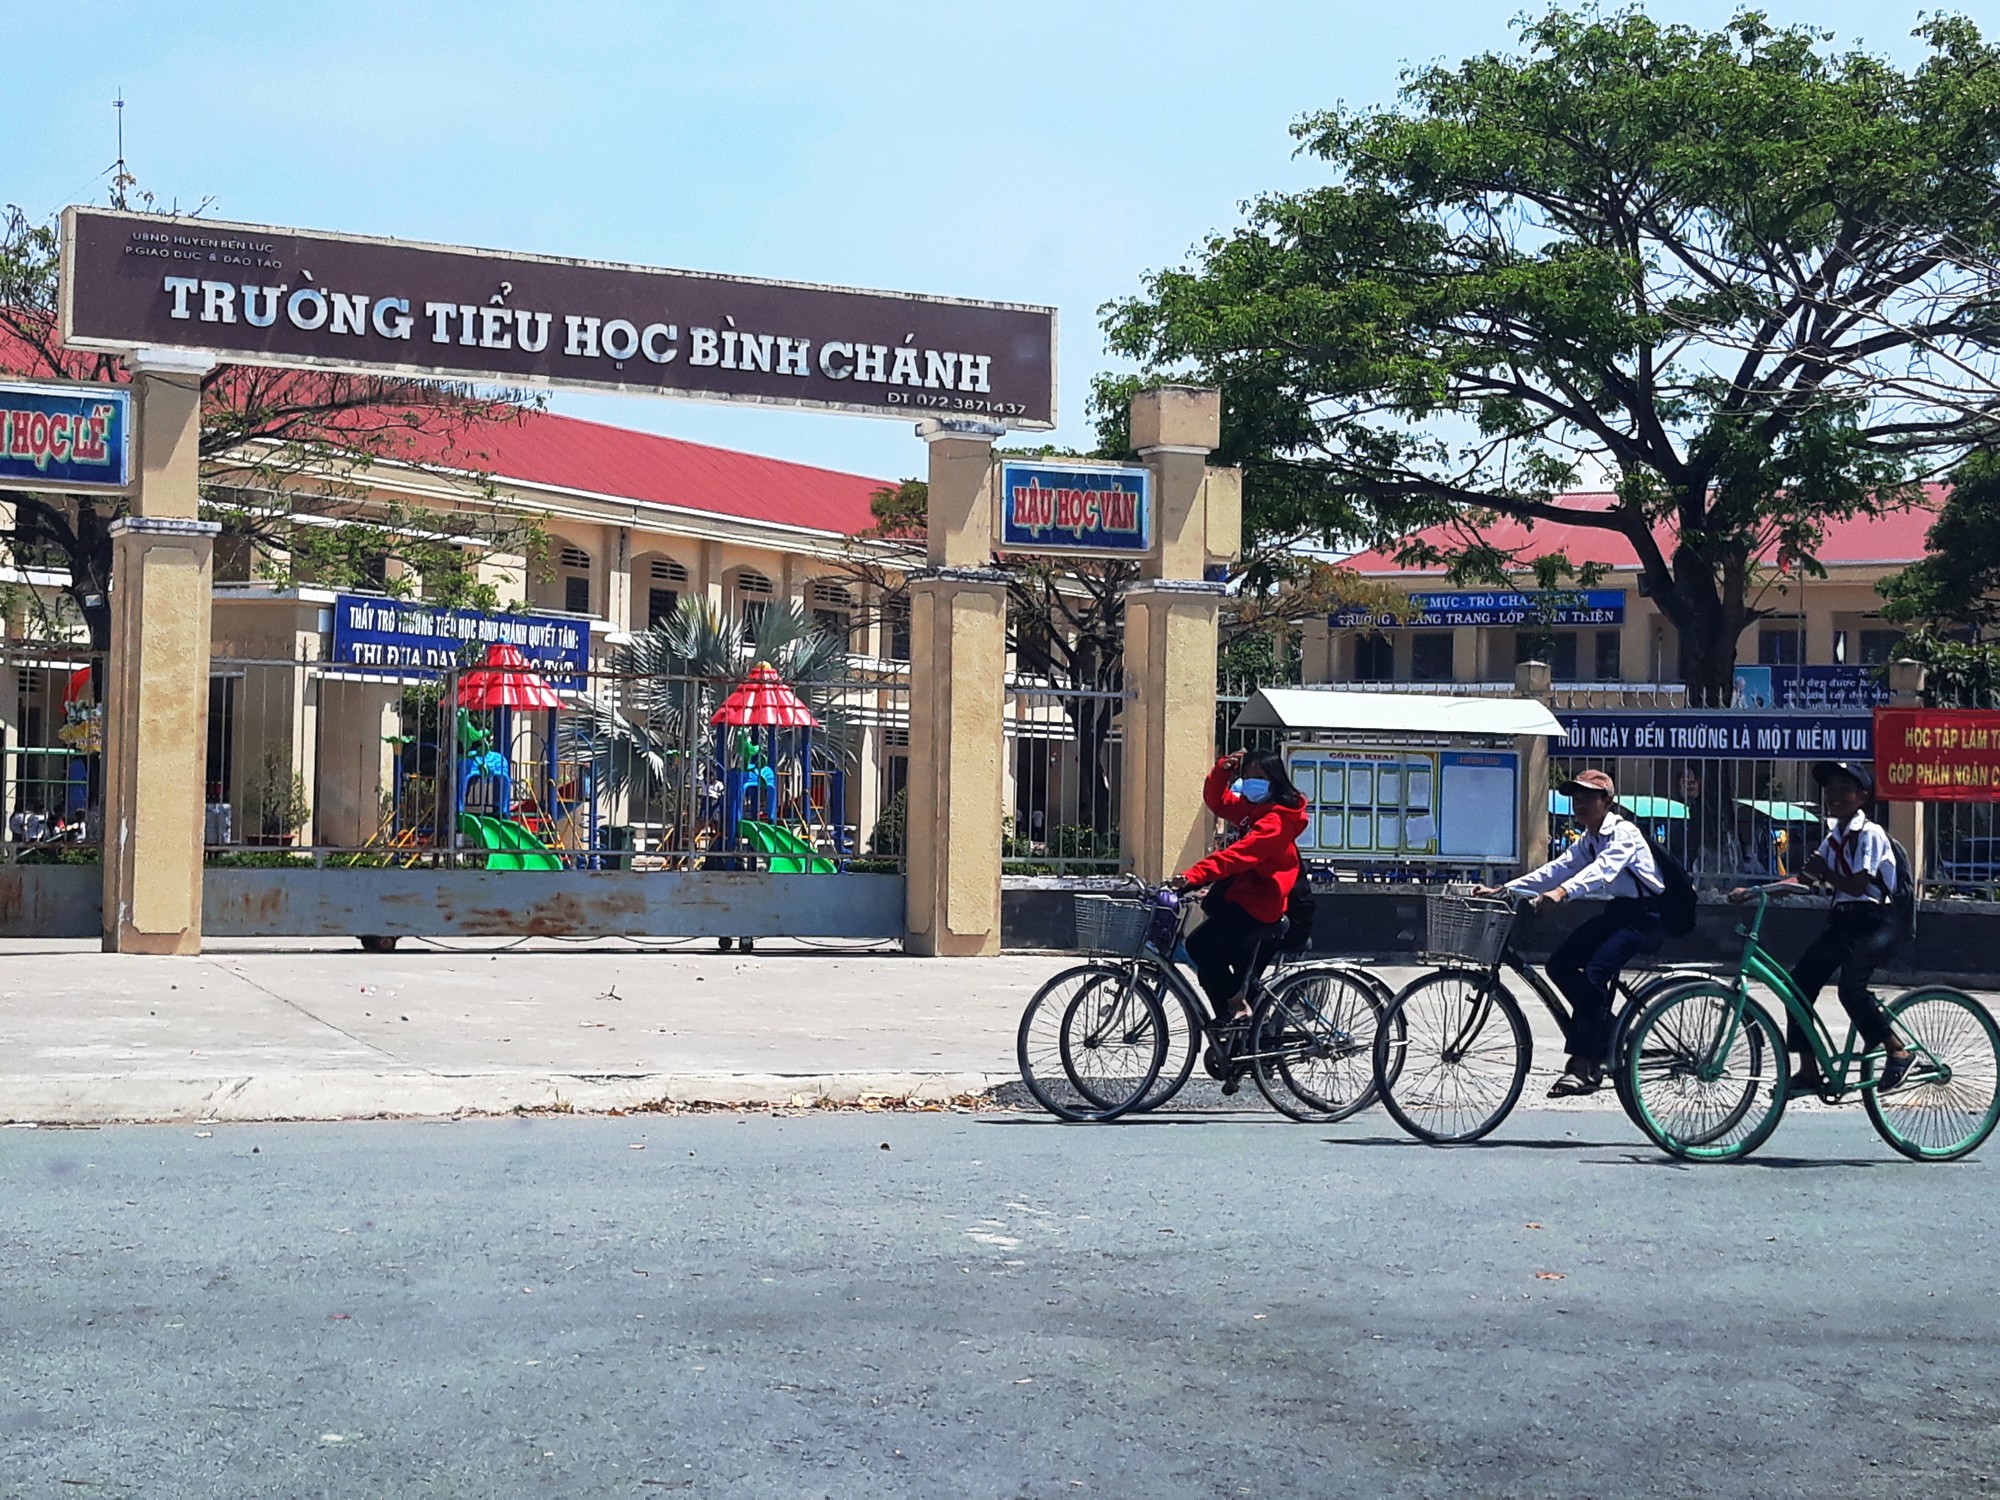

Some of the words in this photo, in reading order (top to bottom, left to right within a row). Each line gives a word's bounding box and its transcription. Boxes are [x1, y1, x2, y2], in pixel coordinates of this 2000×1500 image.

[132, 232, 169, 244] UBND
[164, 269, 415, 340] TRƯỜNG
[425, 281, 553, 353] TIỂU
[563, 314, 679, 370] HỌC
[689, 314, 811, 377] BÌNH
[819, 333, 992, 394] CHÁNH
[916, 394, 1027, 416] 072.3871437
[10, 409, 70, 466] HỌC
[72, 403, 110, 461] LỄ
[1013, 477, 1054, 536] HẬU
[1056, 489, 1097, 537] HỌC
[1099, 483, 1137, 531] VĂN
[1468, 592, 1495, 607] TRÒ
[377, 606, 396, 633] TRÒ
[458, 617, 476, 644] HỌC
[528, 621, 556, 649] QUYẾT
[1446, 613, 1490, 624] TRANG
[352, 643, 382, 666] THI
[1590, 722, 1630, 749] NGÀY
[1634, 721, 1665, 749] ĐẾN
[1669, 723, 1728, 750] TRƯỜNG
[1732, 723, 1751, 750] LÀ
[1757, 724, 1792, 755] MỘT
[1796, 722, 1837, 750] NIỀM
[1841, 728, 1868, 751] VUI
[1905, 727, 1931, 754] HỌC
[1934, 722, 1958, 755] TẬP
[1961, 721, 1988, 750] LÀM
[1888, 757, 1914, 784] GÓP
[1916, 755, 1951, 786] PHẦN
[1953, 760, 1989, 786] NGĂN
